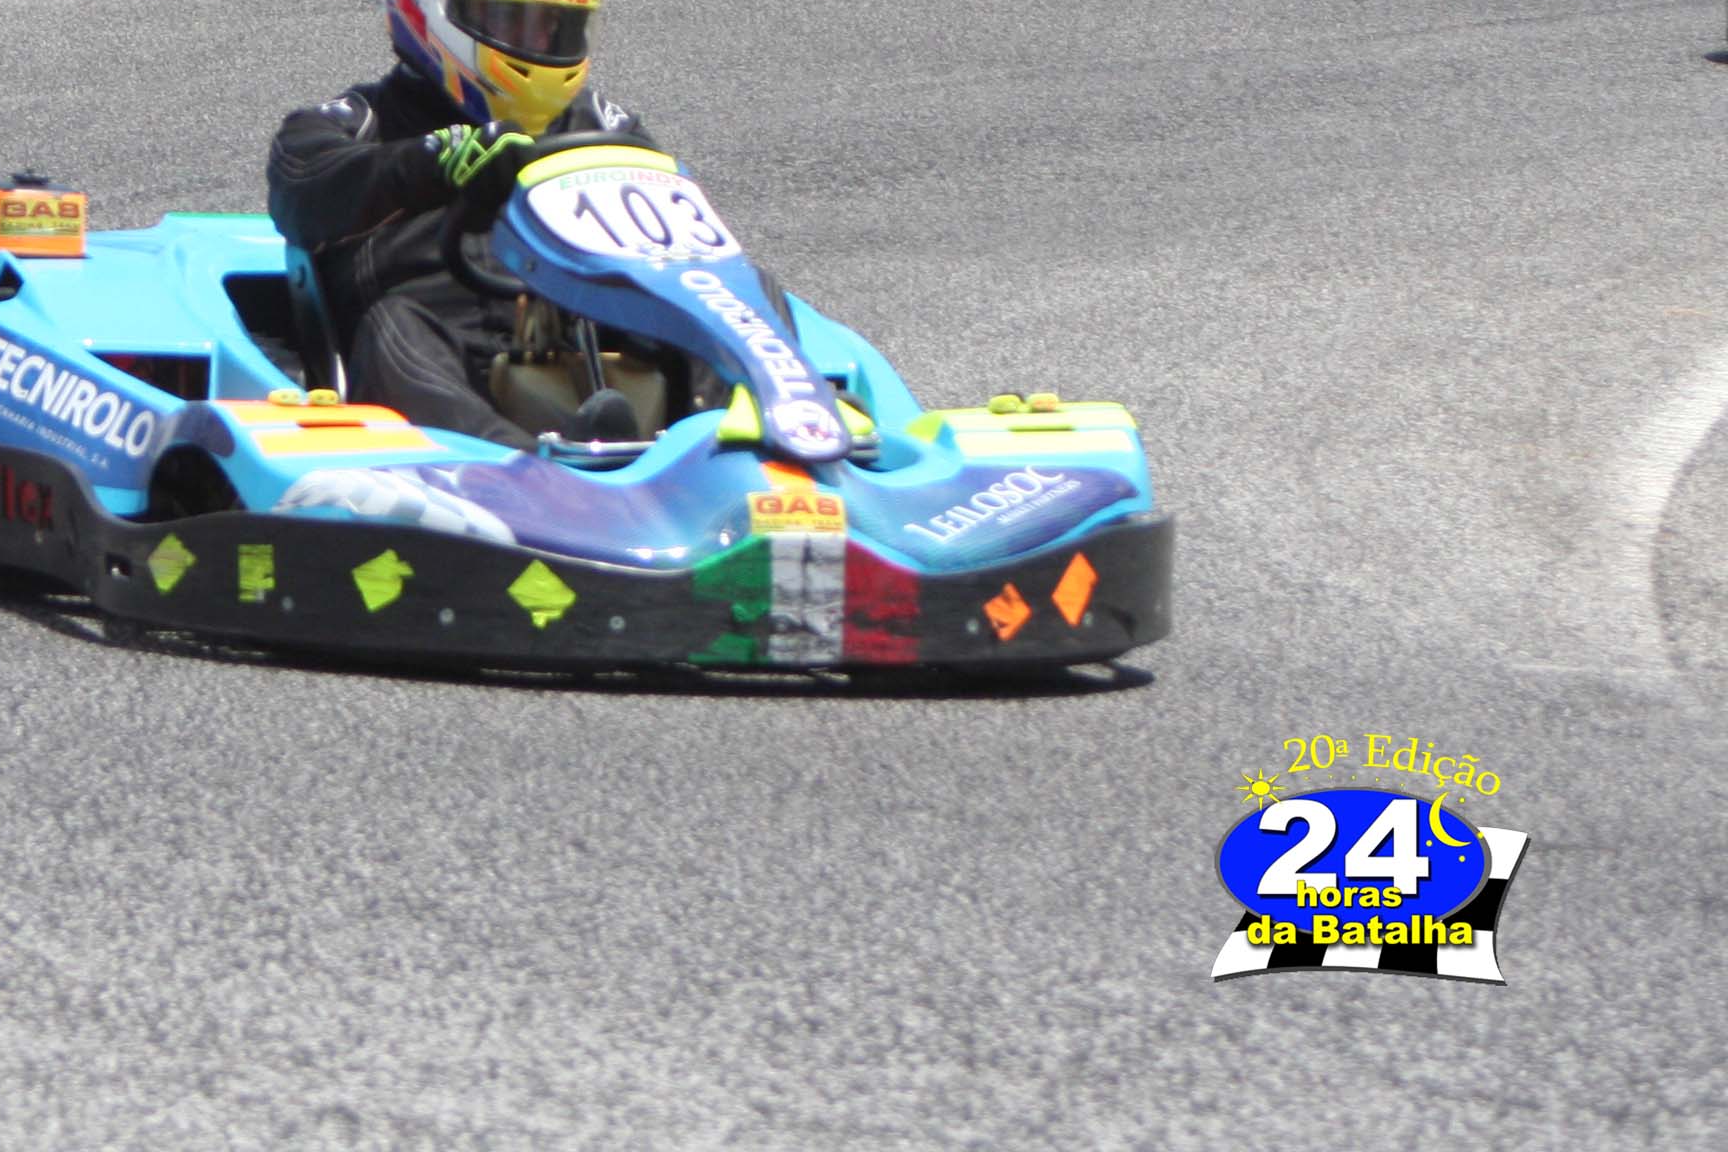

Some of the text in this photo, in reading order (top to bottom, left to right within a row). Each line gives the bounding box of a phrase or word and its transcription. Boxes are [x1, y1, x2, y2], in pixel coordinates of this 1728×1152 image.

[574, 182, 727, 248] 103
[679, 270, 816, 401] TECNIROLO
[903, 464, 1065, 543] LEILOSOC
